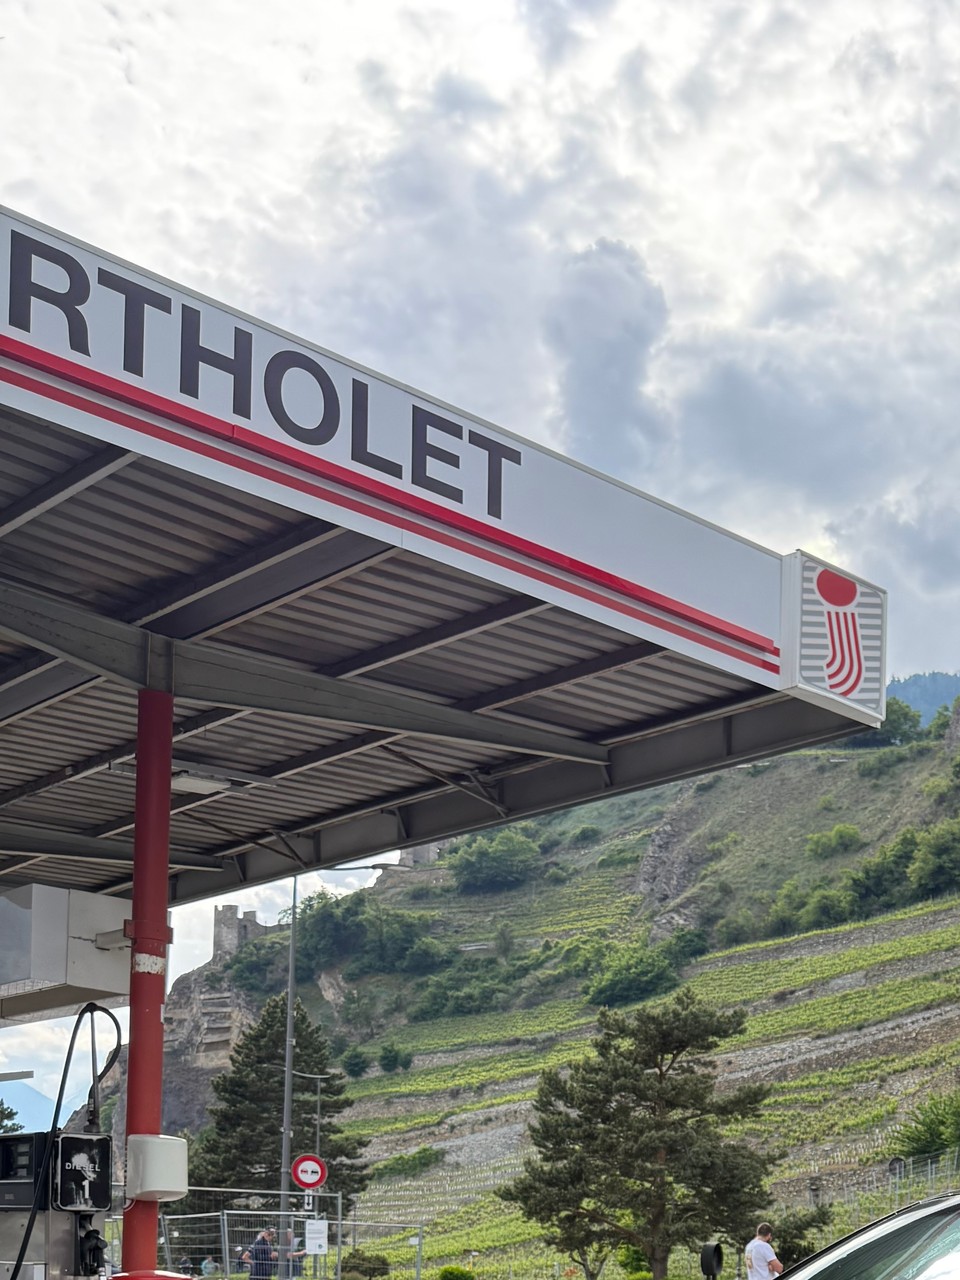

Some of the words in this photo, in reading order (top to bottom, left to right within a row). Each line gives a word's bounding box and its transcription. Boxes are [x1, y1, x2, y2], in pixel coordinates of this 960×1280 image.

[9, 230, 523, 520] RTHOLET
[65, 1162, 101, 1171] DIESEL
[82, 1179, 90, 1199] 1
